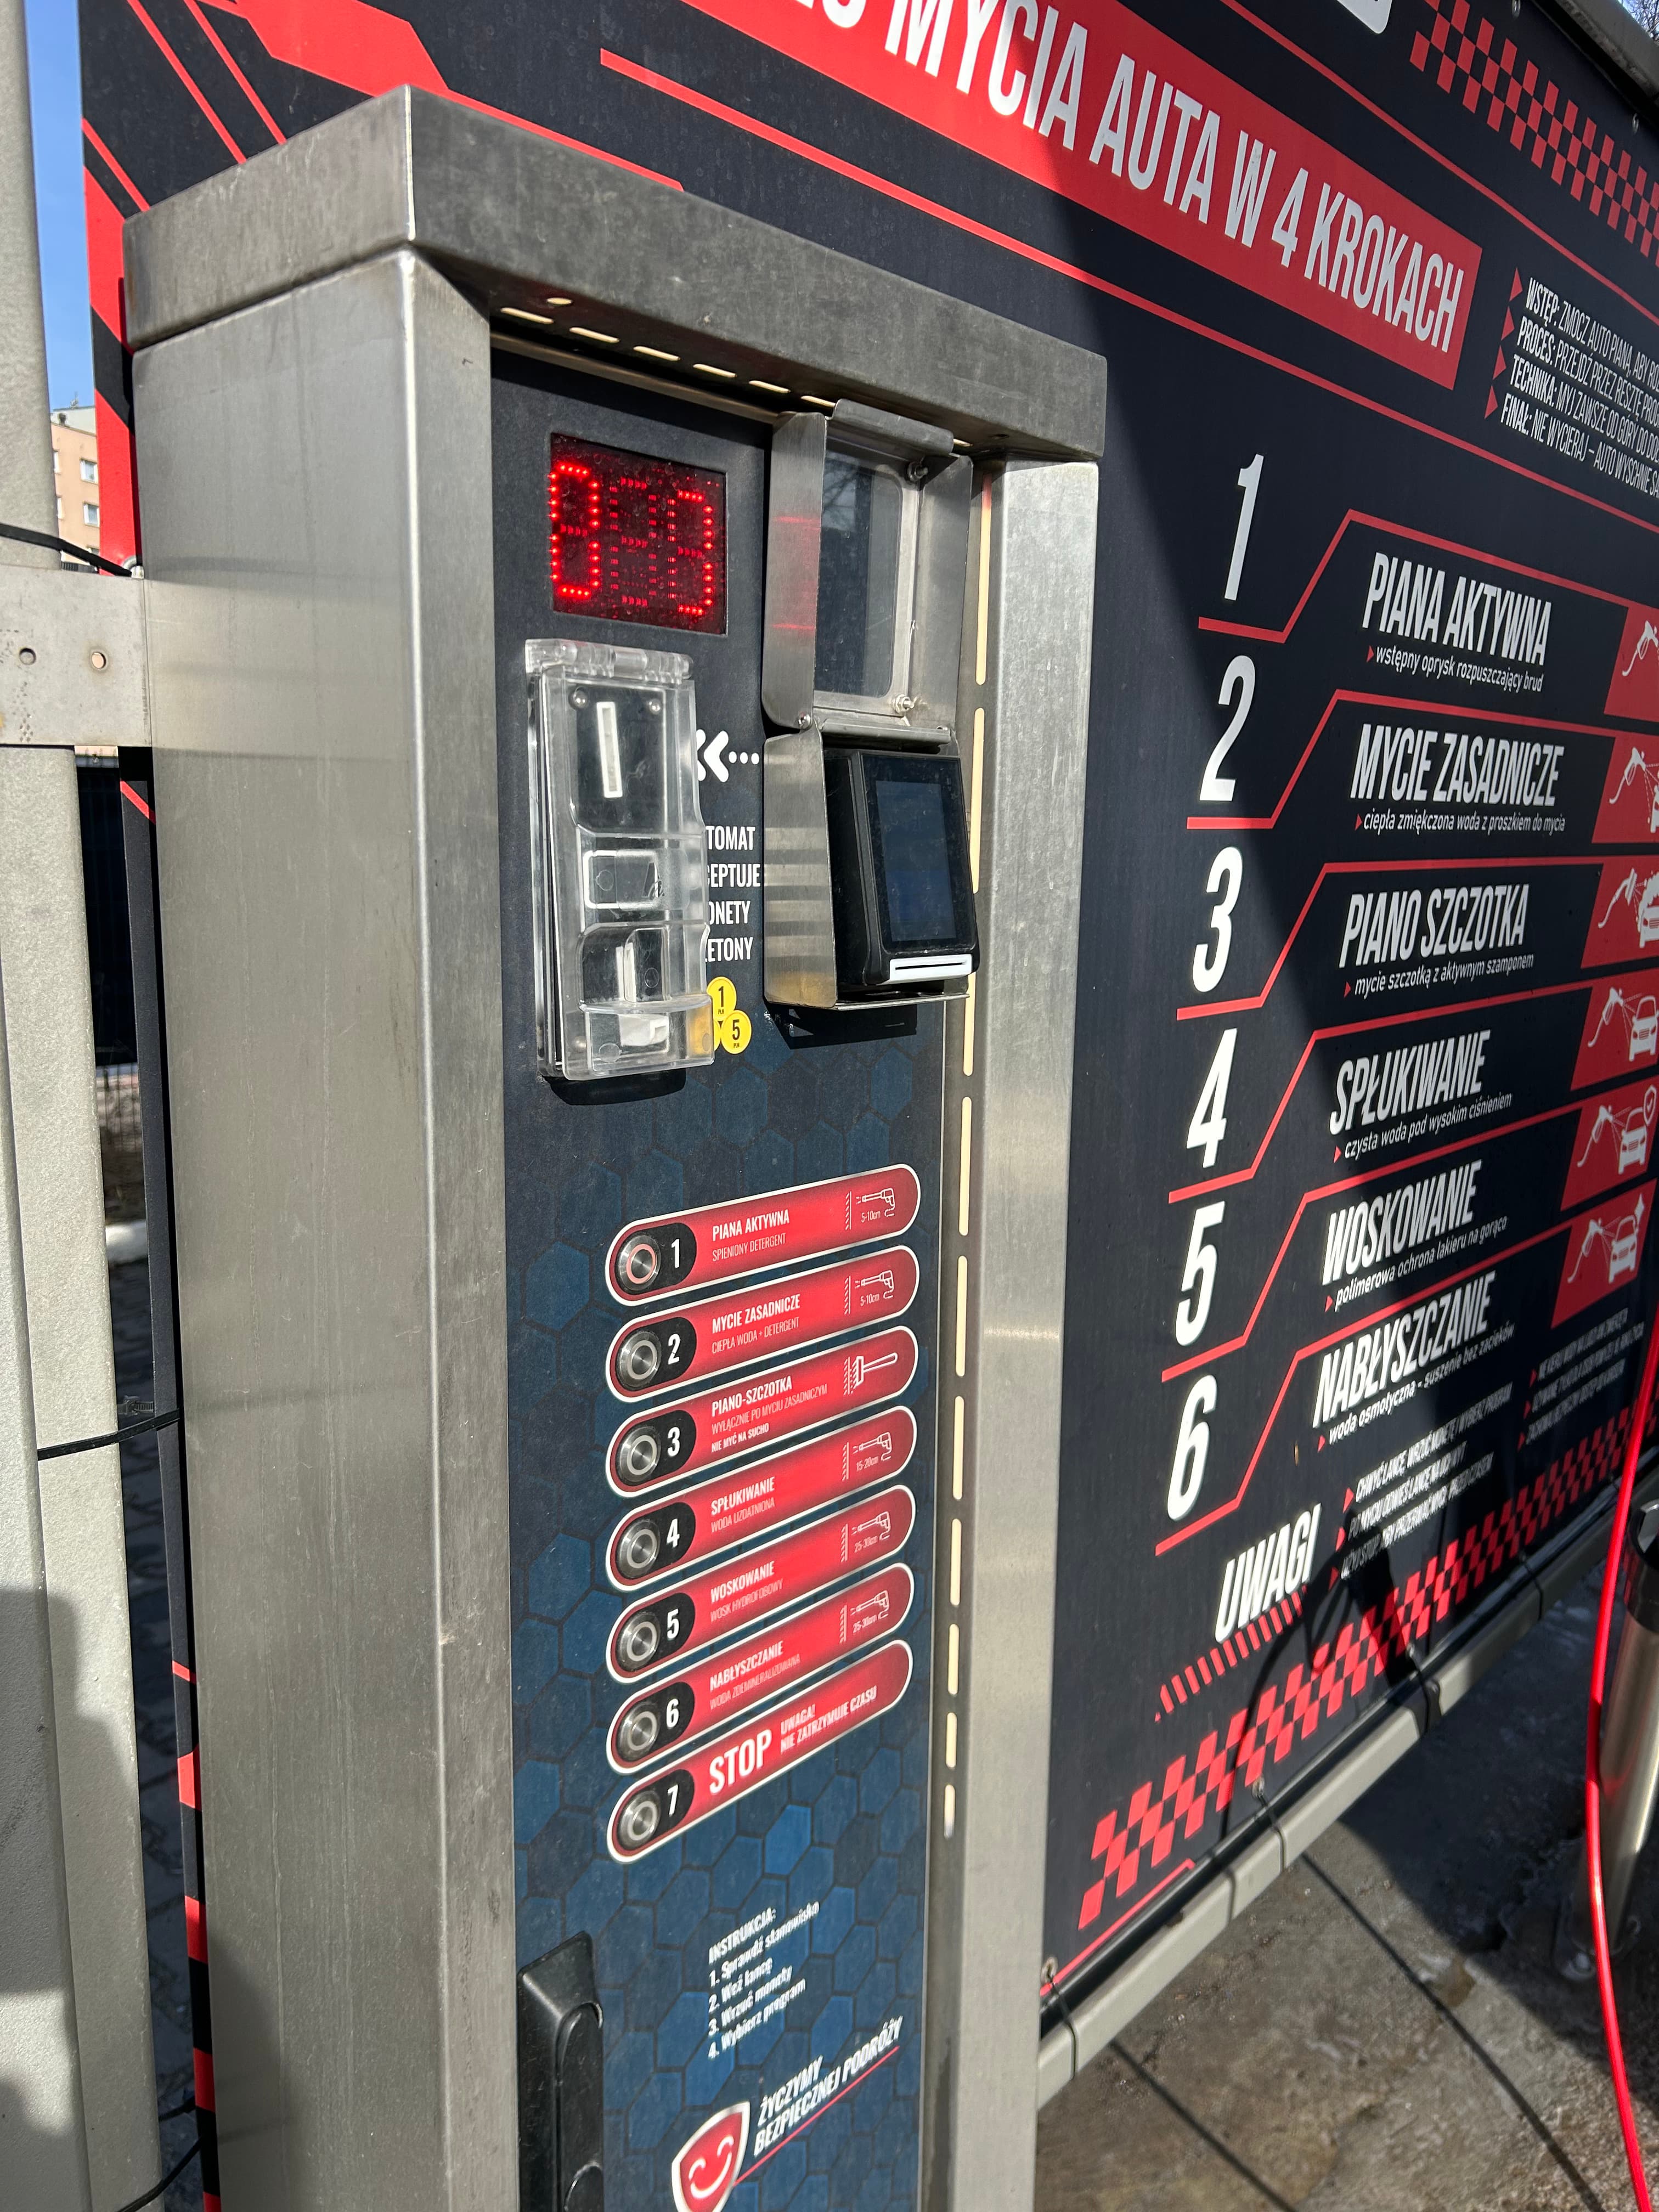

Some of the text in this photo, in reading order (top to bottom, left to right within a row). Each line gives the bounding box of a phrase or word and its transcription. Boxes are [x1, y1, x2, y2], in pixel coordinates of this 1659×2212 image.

[884, 0, 1464, 353] MYCIA AUTA W 4 KROKACH
[1526, 277, 1560, 327] WSTĘP:
[1558, 301, 1590, 345] ZMOCZ
[1587, 320, 1611, 357] AUTO
[1633, 352, 1650, 382] ABY
[1647, 360, 1659, 393] RO
[1517, 316, 1659, 428] PROCES: PRZEJDŹ PRZEZ RESZTĘ PROG
[1510, 354, 1659, 464] TECHNIKA: MYJ ZAWSZE OD GÓRY DO DOŁ
[1500, 393, 1659, 499] FINAŁ: NIE WYCIERAJ AUTO WYSCHNIE SA
[1224, 453, 1264, 601] 1
[1362, 552, 1552, 666] PIANA AKTYWNA
[1376, 646, 1543, 693] wstępny oprysk rozpuszczający brud
[1199, 655, 1256, 802] 2
[1350, 723, 1565, 806] MYCIE ZASADNICZE
[706, 826, 755, 850] TOMAT
[1363, 808, 1565, 836] ciepła zmiękczona woda z proszkiem do mycia
[707, 864, 760, 887] EPTUJE
[709, 901, 751, 924] ONETY
[1192, 845, 1243, 992] 3
[1339, 884, 1529, 968] PIANO SZCZOTKA
[705, 937, 753, 962] ETONY
[719, 986, 724, 1007] 1
[1355, 953, 1534, 999] mycie szczotką z aktywnym szamponem
[732, 1019, 740, 1040] 5
[1186, 1028, 1238, 1168] 4
[1329, 1029, 1491, 1135] SPŁUKIWANIE
[1345, 1093, 1512, 1160] czysta woda pod wysokim ciśnieniem
[713, 1209, 789, 1242] PIANA AKTYWNA
[861, 1211, 881, 1223] 5-10cm
[1322, 1159, 1482, 1286] WOSKOWANIE
[672, 1239, 680, 1268] 1
[713, 1233, 786, 1261] SPIENIONY DETERGENT
[1335, 1216, 1508, 1312] polimerowa ochrona lakieru na gorąco
[1175, 1201, 1226, 1346] 5
[713, 1294, 800, 1334] MYCIE ZASADNICZE
[860, 1294, 879, 1306] 5-10cm
[668, 1334, 680, 1365] 2
[712, 1339, 735, 1353] CIEPŁA
[737, 1330, 757, 1346] WODA
[764, 1317, 799, 1338] DETERGENT
[1312, 1270, 1496, 1428] NABŁYSZCZANIE
[712, 1376, 792, 1417] PIANO-SZCZOTKA
[712, 1384, 828, 1435] WYŁĄCZNIE PO MYCIU ZASADNICZYM
[1329, 1414, 1357, 1445] woda
[1359, 1380, 1416, 1424] osmotyczna
[1424, 1355, 1462, 1388] suszenie
[1463, 1344, 1478, 1365] bez
[668, 1426, 680, 1457] 3
[712, 1423, 769, 1452] NIE MYĆ NA SUCHO
[1166, 1374, 1217, 1521] 6
[711, 1476, 775, 1515] SPŁUKIWANIE
[711, 1497, 775, 1532] WODA UZDATNIONA
[667, 1518, 680, 1549] 4
[711, 1561, 775, 1603] WOSKOWANIE
[1215, 1503, 1322, 1643] UWAGI
[667, 1609, 679, 1639] 5
[710, 1603, 731, 1622] WOSK
[710, 1640, 783, 1692] NABŁYSZCZANIE
[667, 1699, 679, 1729] 6
[710, 1690, 731, 1709] WODA
[780, 1685, 877, 1754] NIE ZATRZYMUJE CZASU
[781, 1704, 816, 1735] UWAGA!
[709, 1729, 772, 1795] STOP
[668, 1785, 678, 1815] 7
[709, 1907, 777, 1965] INSTRUKCJA:
[710, 1901, 820, 1988] 1. Sprawdź stanowisko
[708, 1978, 806, 2059] 4. Wybierz program
[709, 1994, 720, 2013] 2.
[709, 2018, 720, 2036] 3.
[754, 2016, 903, 2157] BEZPIECZNEJ PODRÓŻY
[758, 2055, 823, 2127] ŻYCZYMY
